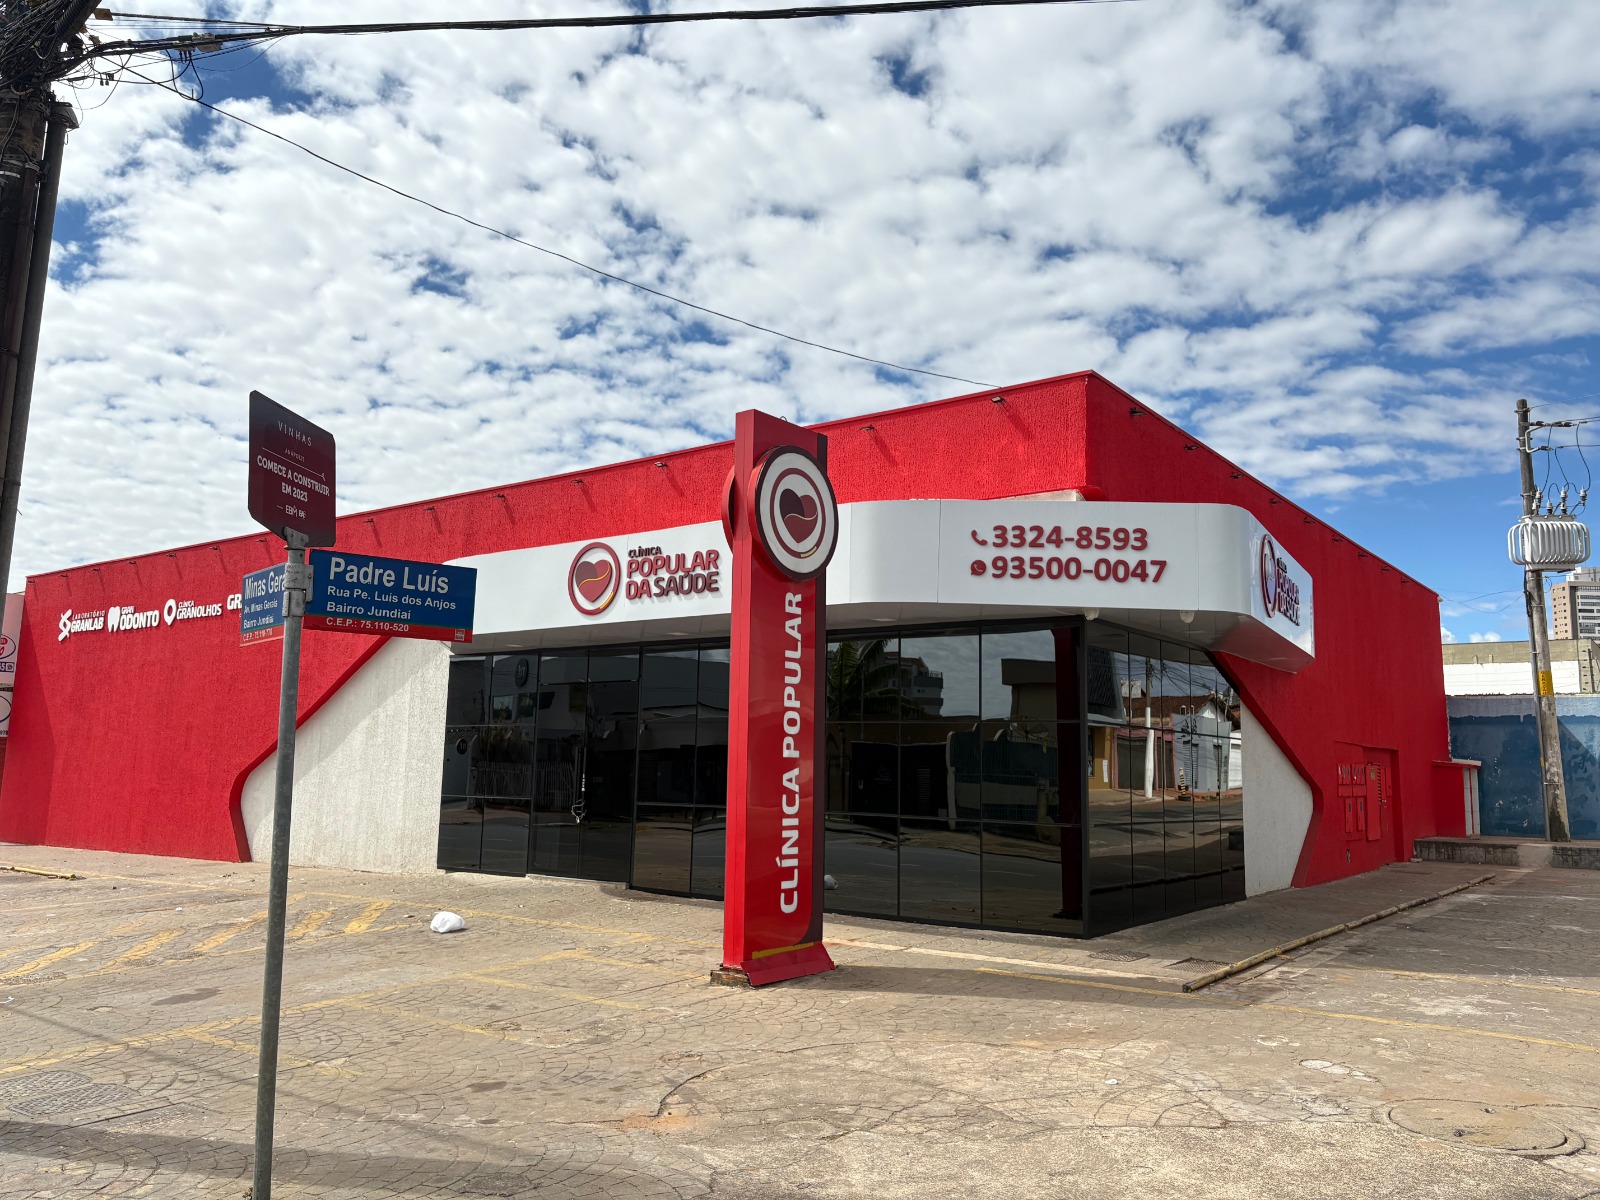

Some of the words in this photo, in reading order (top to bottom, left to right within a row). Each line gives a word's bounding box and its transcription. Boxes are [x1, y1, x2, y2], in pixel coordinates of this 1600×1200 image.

[278, 420, 312, 446] VINHAS
[256, 454, 287, 478] COMECE
[287, 469, 292, 480] A
[294, 471, 330, 496] CONSTRUIR
[282, 482, 292, 496] EM
[292, 487, 308, 502] 2023
[992, 524, 1148, 551] 3324-8593
[628, 546, 662, 558] CLÍNICA
[626, 549, 720, 578] POPULAR
[991, 556, 1168, 583] 93500-0047
[244, 576, 266, 600] Minas
[268, 571, 286, 594] Gera
[329, 556, 396, 587] Padre
[403, 566, 450, 594] Luís
[626, 580, 652, 600] DA
[652, 571, 720, 598] SAÚDE
[227, 594, 242, 610] GR
[251, 602, 263, 613] Minas
[264, 598, 278, 610] Gerais
[328, 586, 350, 598] Rua
[353, 589, 371, 600] Pe.
[374, 590, 398, 603] Luís
[402, 592, 422, 606] dos
[425, 596, 456, 610] Anjos
[120, 610, 160, 631] ODONTO
[121, 606, 135, 614] GRAN
[176, 604, 222, 620] GRANOLHOS
[326, 601, 365, 616] Bairro
[368, 606, 411, 620] Jundiaí
[70, 617, 104, 633] GRANLAB
[243, 619, 257, 629] Bairro
[326, 617, 358, 628] C.E.P.:
[360, 620, 409, 632] 75.110-520
[782, 592, 803, 758] POPULAR
[775, 767, 800, 914] CLÍNICA
